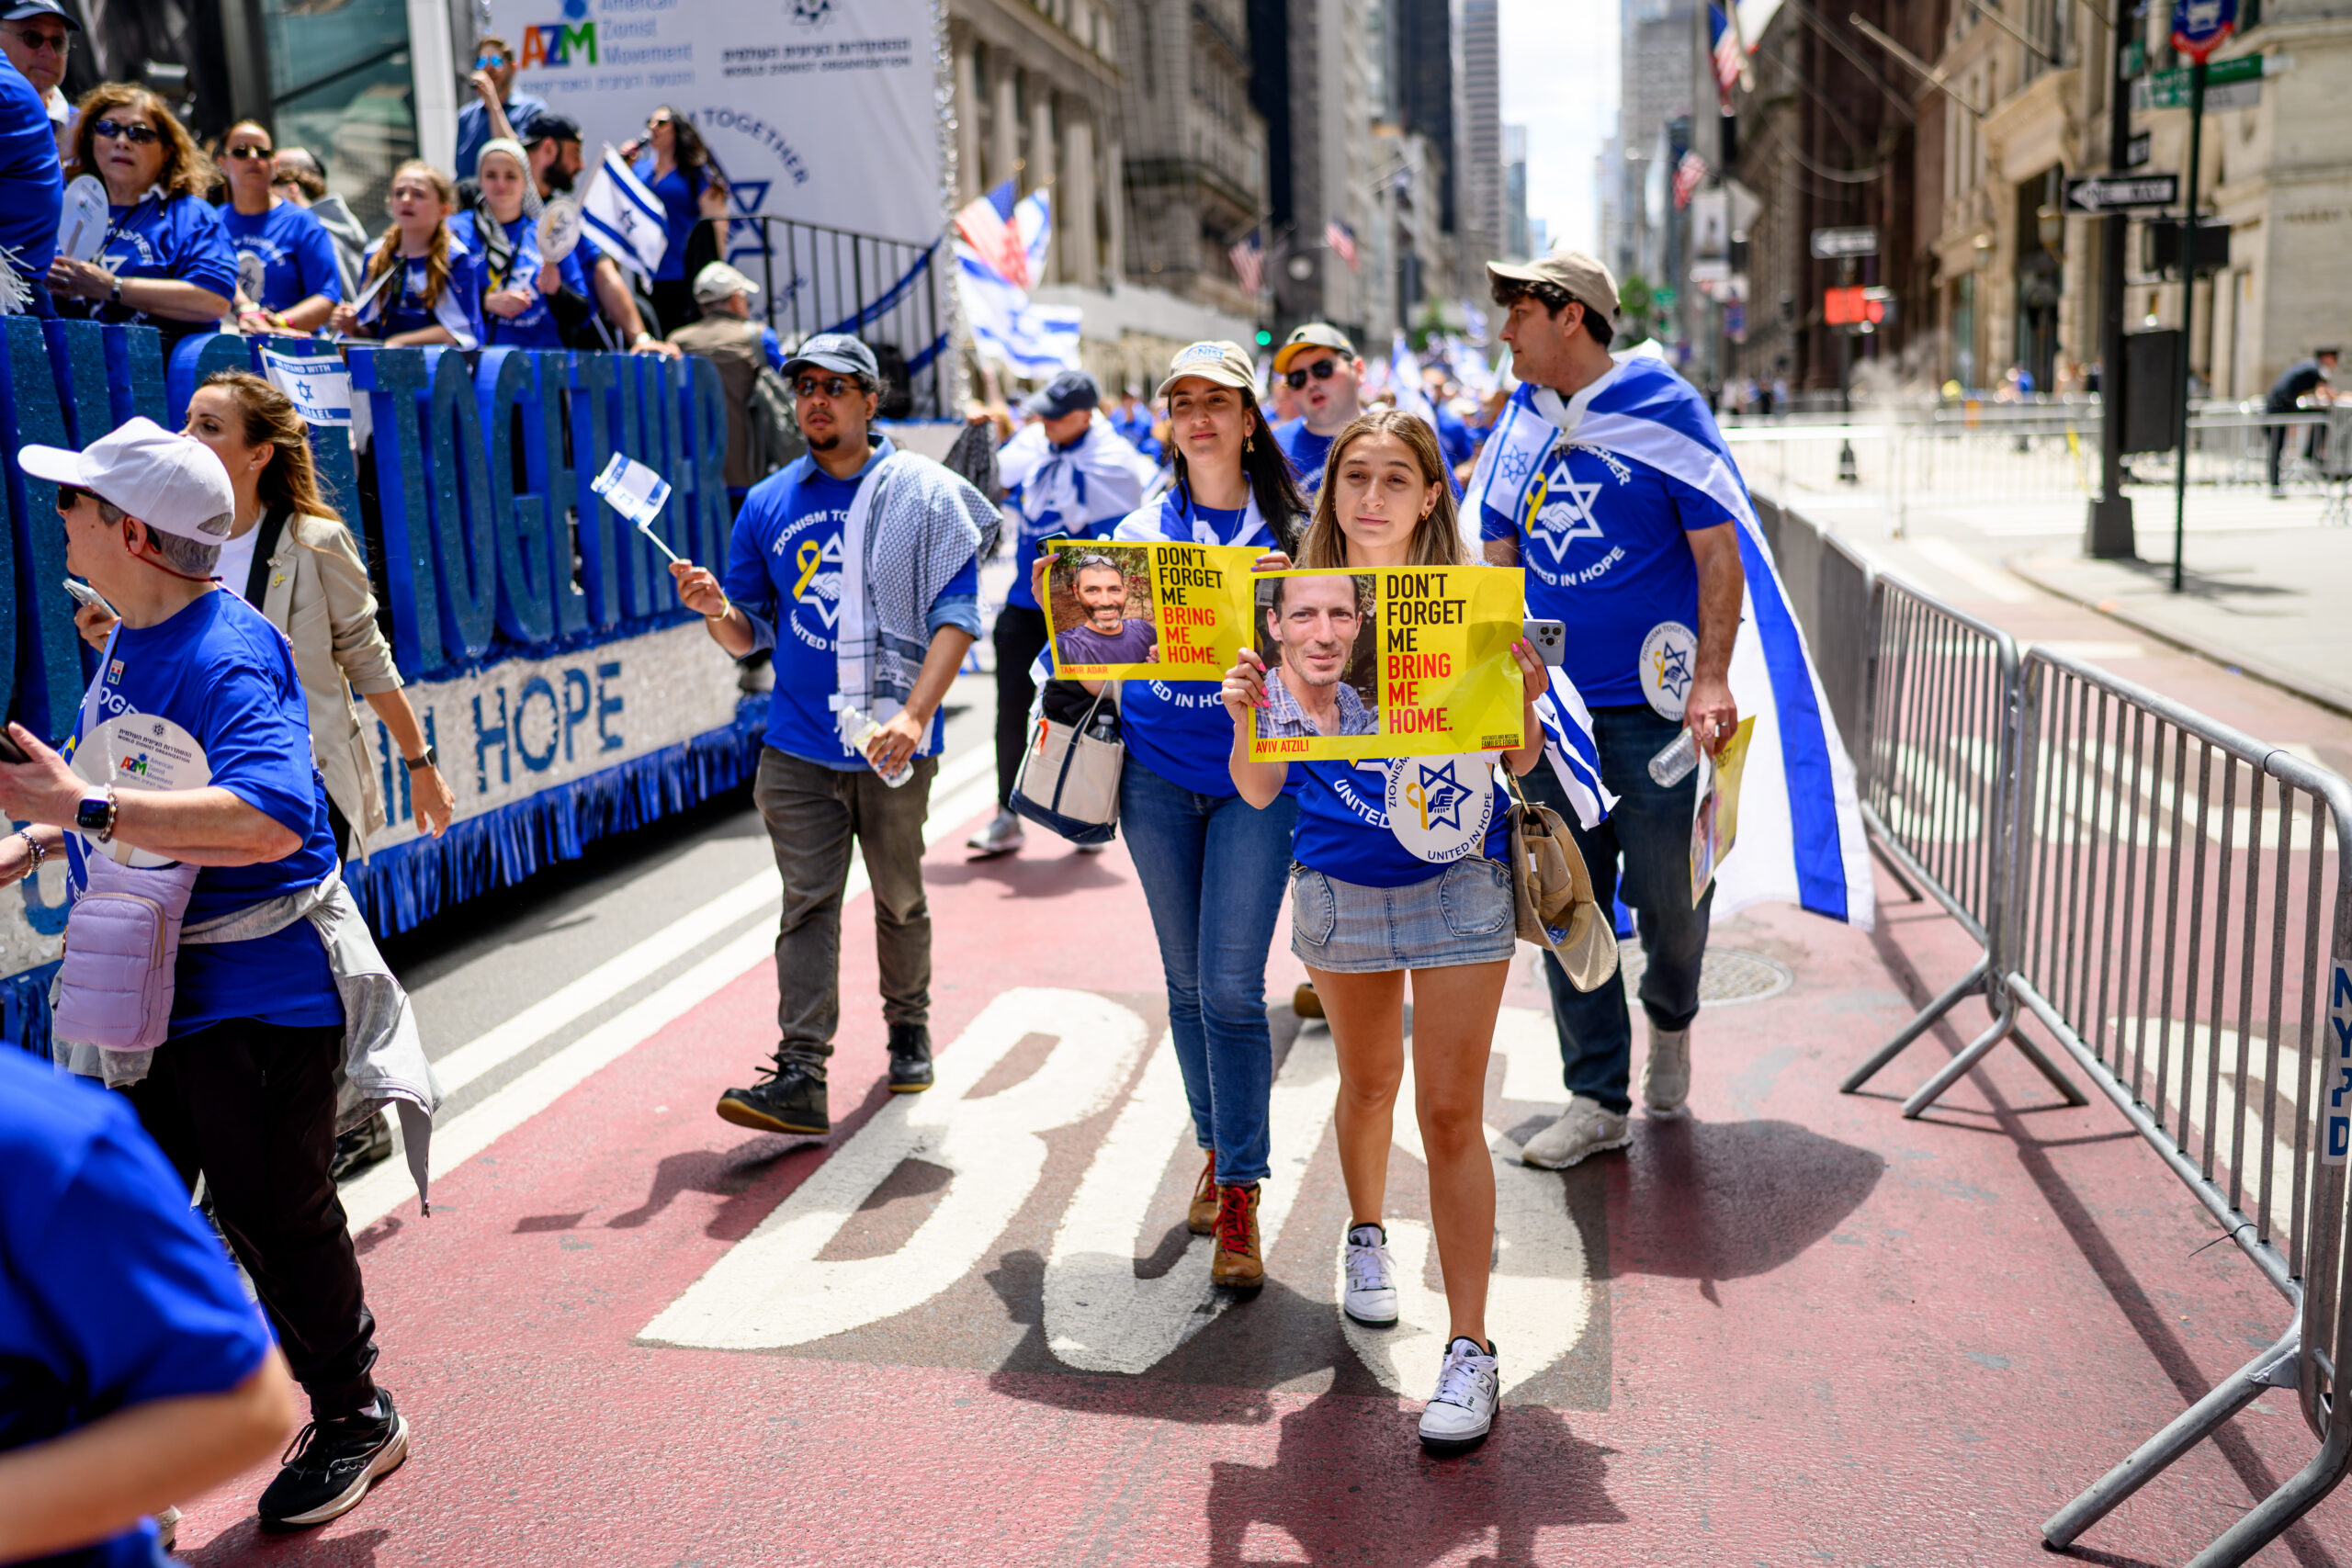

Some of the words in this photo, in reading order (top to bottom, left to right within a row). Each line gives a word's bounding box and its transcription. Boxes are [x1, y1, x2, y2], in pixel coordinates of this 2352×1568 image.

[521, 22, 597, 69] AZM
[603, 44, 694, 67] Movement
[703, 106, 809, 187] TOGETHER
[307, 364, 332, 373] WITH
[773, 511, 827, 556] ZIONISM
[1157, 547, 1206, 568] DON'T
[1525, 547, 1556, 586] UNITED
[1560, 572, 1577, 587] IN
[1579, 546, 1626, 583] HOPE
[1159, 567, 1223, 590] FORGET
[1386, 573, 1448, 600] DON'T
[1161, 587, 1187, 605] ME
[1163, 606, 1216, 626] BRING
[1386, 599, 1466, 626] FORGET
[790, 609, 827, 650] UNITED
[1165, 626, 1192, 644] ME
[1387, 627, 1418, 653] ME
[1168, 645, 1221, 665] HOME.
[1642, 627, 1662, 662] ZIONISM
[1060, 666, 1084, 675] TAMIR
[1087, 666, 1109, 675] ADAR
[1387, 653, 1452, 680] BRING
[1175, 693, 1193, 708] IN
[1199, 692, 1224, 708] HO
[1388, 682, 1419, 707] ME
[471, 660, 624, 794] HOPE
[1389, 707, 1453, 735] HOME.
[118, 734, 135, 744] WORLD
[135, 740, 154, 750] ZIONIST
[154, 748, 191, 763] ORGANIZATION
[1256, 740, 1278, 753] AVIV
[1281, 739, 1309, 752] ATZILI
[1481, 739, 1501, 748] FAMILIES
[1503, 739, 1520, 747] FORUM
[120, 755, 147, 776] AZM
[150, 757, 174, 770] American
[146, 772, 174, 785] Movement
[1388, 756, 1410, 808] ZIONISM
[1334, 779, 1391, 829] UNITED
[1427, 840, 1470, 861] UNITED
[1470, 830, 1481, 845] IN
[1480, 792, 1493, 831] HOPE
[636, 987, 1592, 1403] BUS
